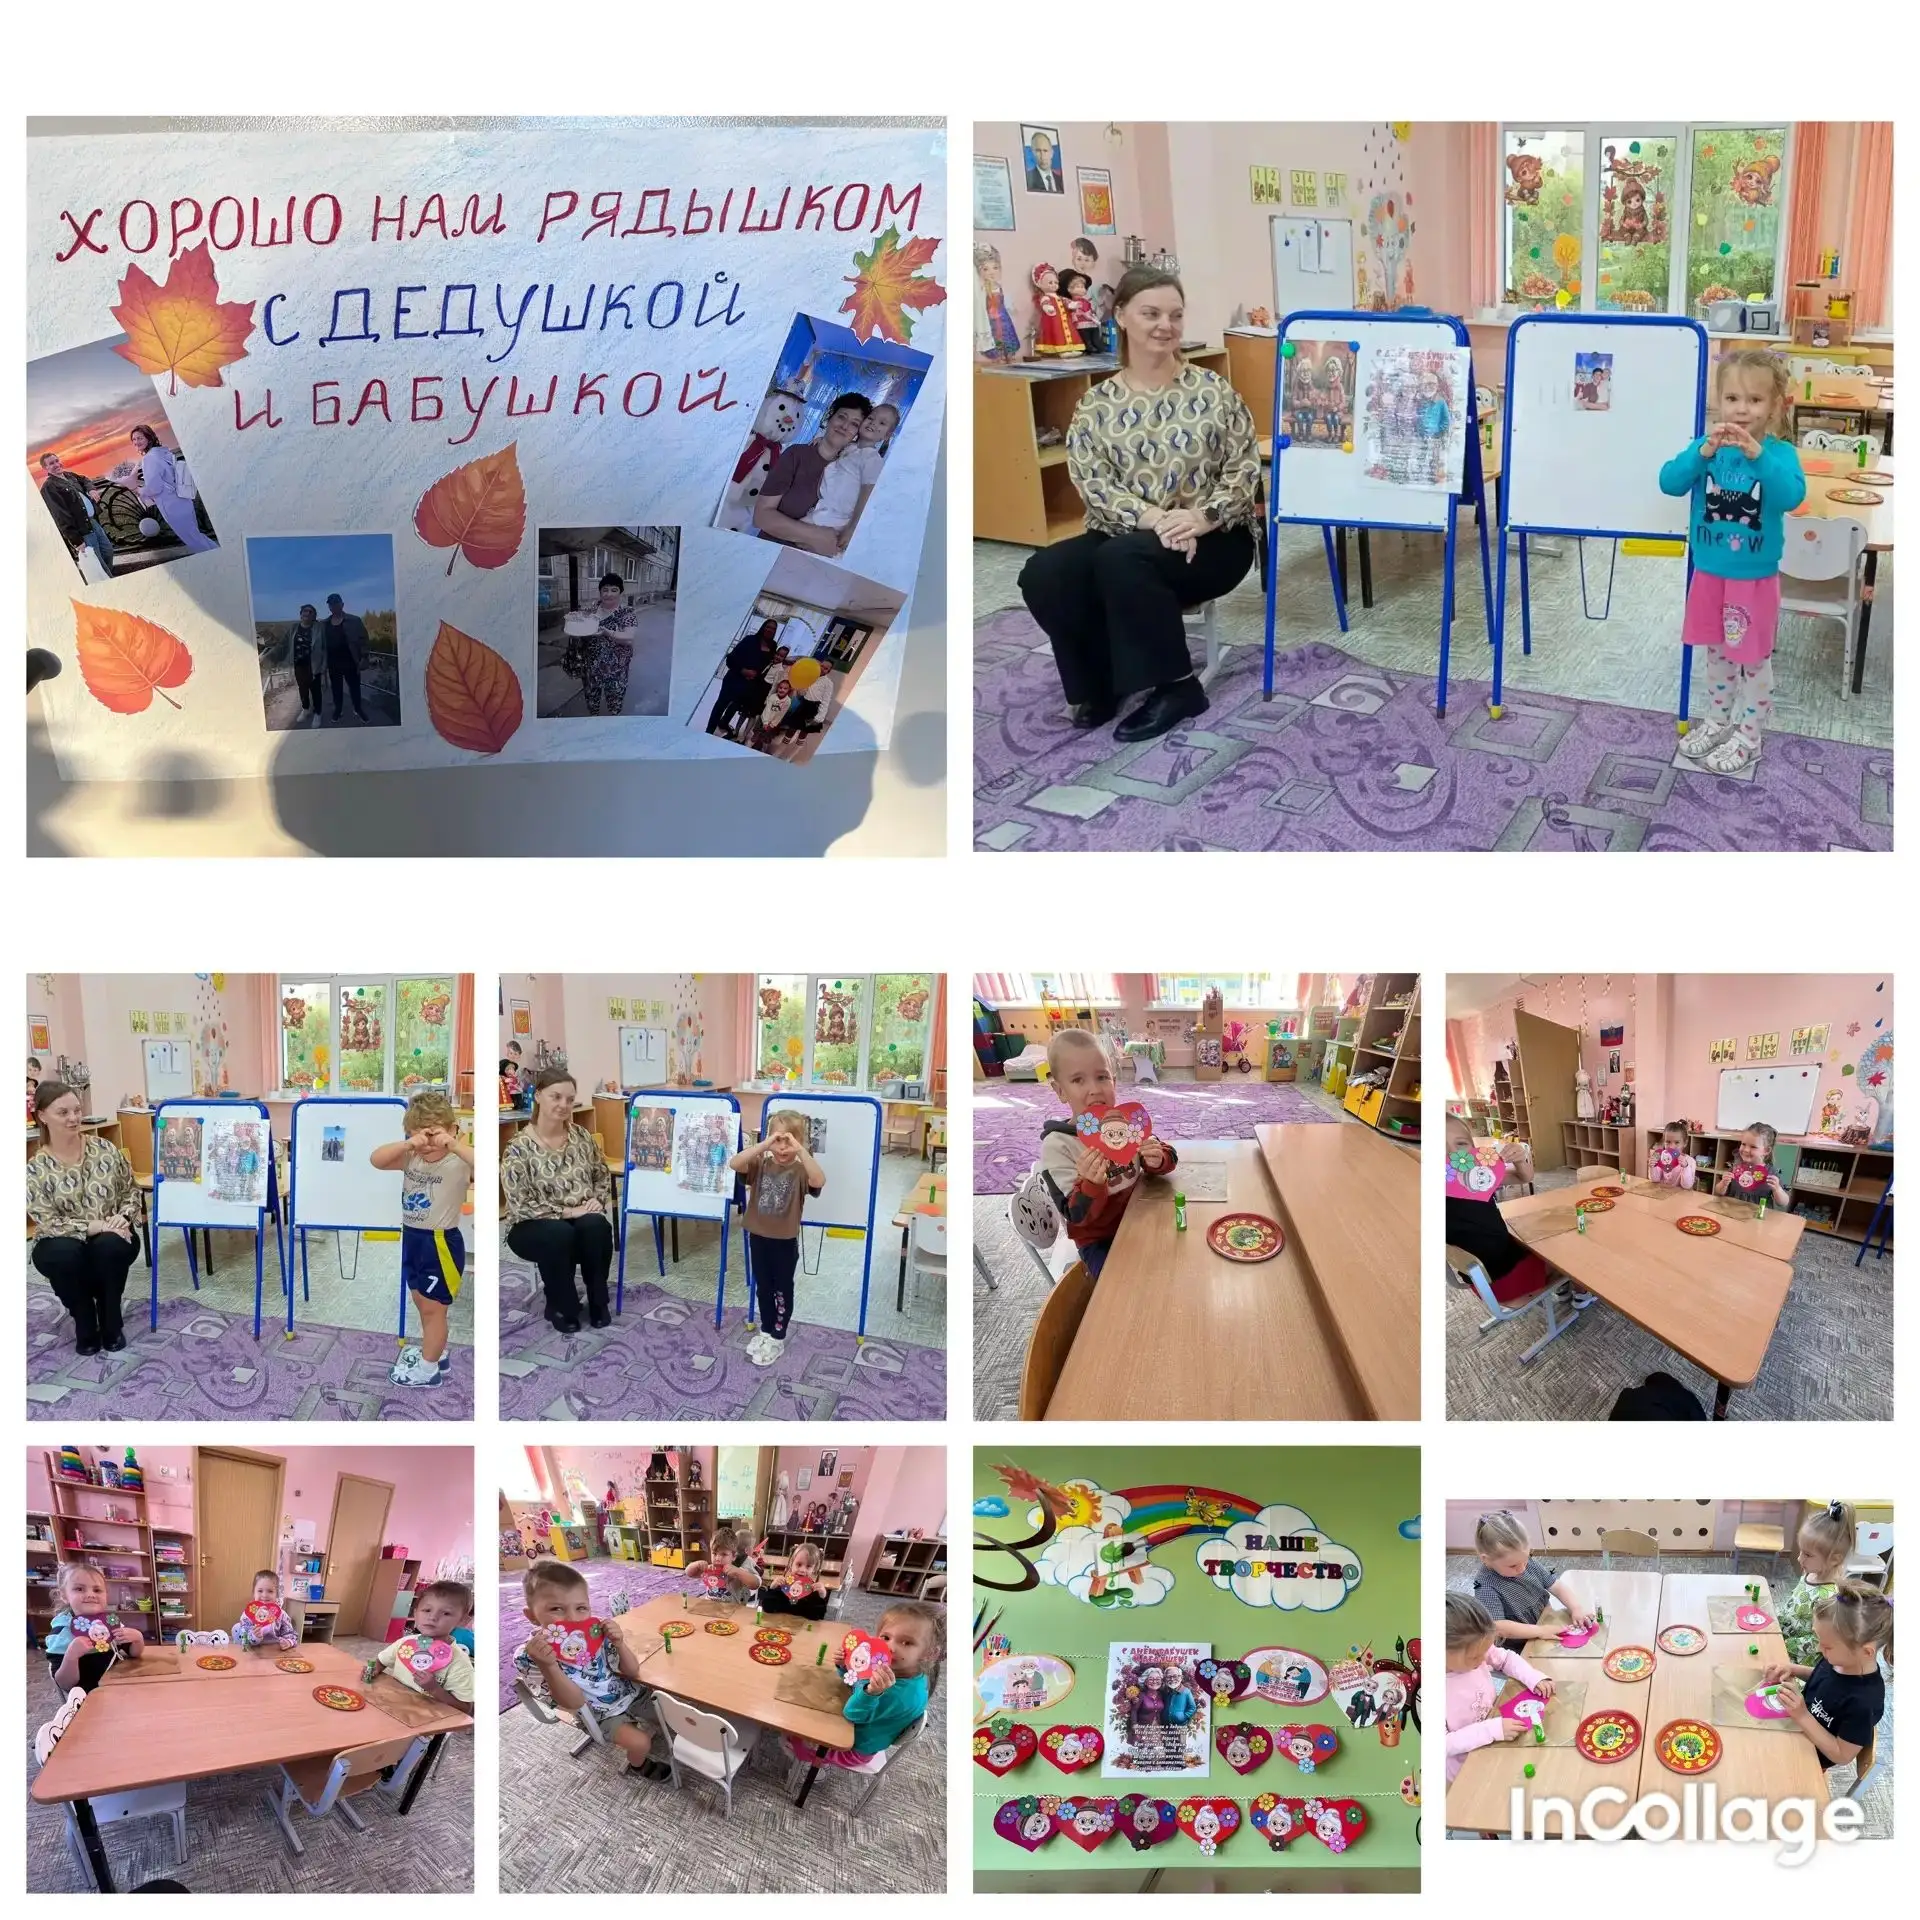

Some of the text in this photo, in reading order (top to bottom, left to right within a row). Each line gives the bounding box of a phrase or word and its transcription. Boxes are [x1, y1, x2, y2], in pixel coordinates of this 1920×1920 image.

[55, 192, 343, 262] ХОРОШО
[371, 193, 507, 242] НАМ
[537, 182, 924, 244] РЯДЫШКОМ
[263, 271, 746, 363] С ДЕДУШКОЙ
[233, 388, 283, 431] И
[426, 1275, 439, 1294] 7
[1245, 1534, 1319, 1552] НАШЕ
[1203, 1559, 1359, 1580] ТВОРЧЕСТВО
